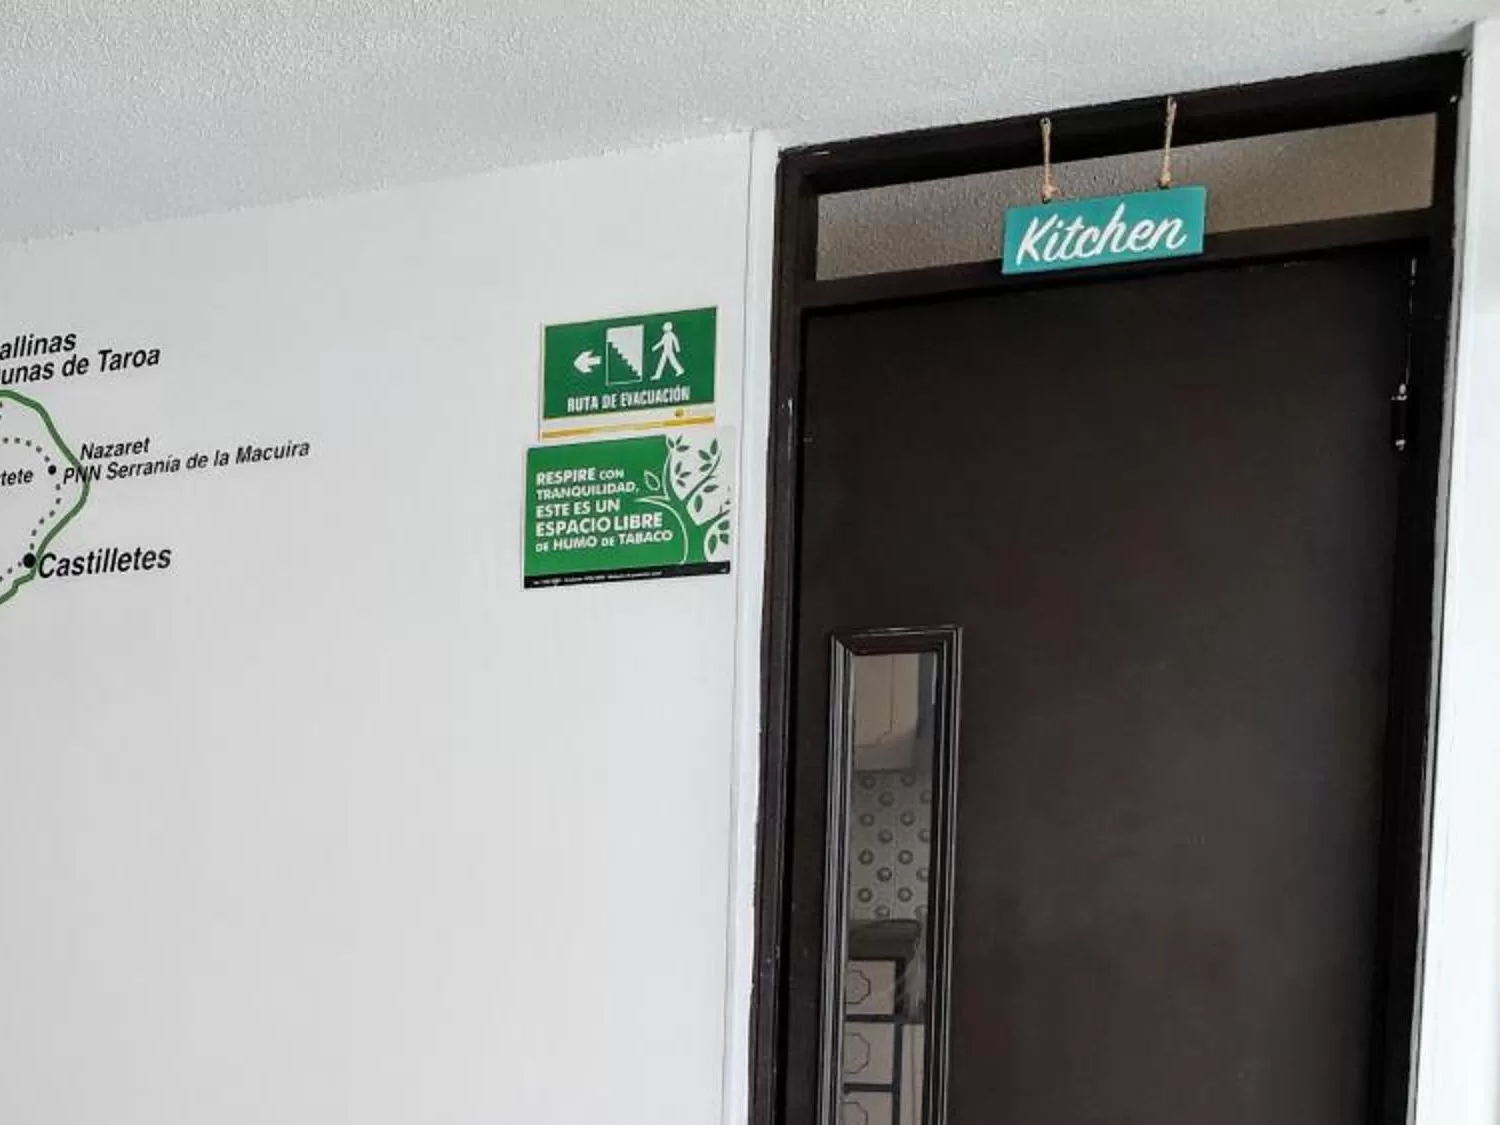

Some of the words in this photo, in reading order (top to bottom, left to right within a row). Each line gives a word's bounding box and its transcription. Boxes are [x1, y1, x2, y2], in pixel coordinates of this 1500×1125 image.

[1016, 203, 1187, 265] Kitchen
[62, 354, 89, 376] de
[98, 348, 161, 372] Taroa
[567, 395, 598, 412] RUTA
[601, 394, 617, 409] DE
[620, 386, 691, 408] EVACUACIÓN
[80, 437, 150, 460] Nazaret
[63, 464, 101, 485] PNN
[186, 453, 209, 470] de
[213, 449, 229, 467] la
[235, 440, 311, 465] Macuira
[536, 467, 596, 486] RESPIRE
[536, 502, 570, 519] ESTE
[574, 501, 590, 515] ES
[595, 498, 621, 514] UN
[536, 517, 610, 538] ESPACIO
[614, 512, 663, 533] LIBRE
[553, 535, 597, 551] HUMO
[618, 529, 673, 546] TABACO
[38, 547, 173, 579] Castilletes
